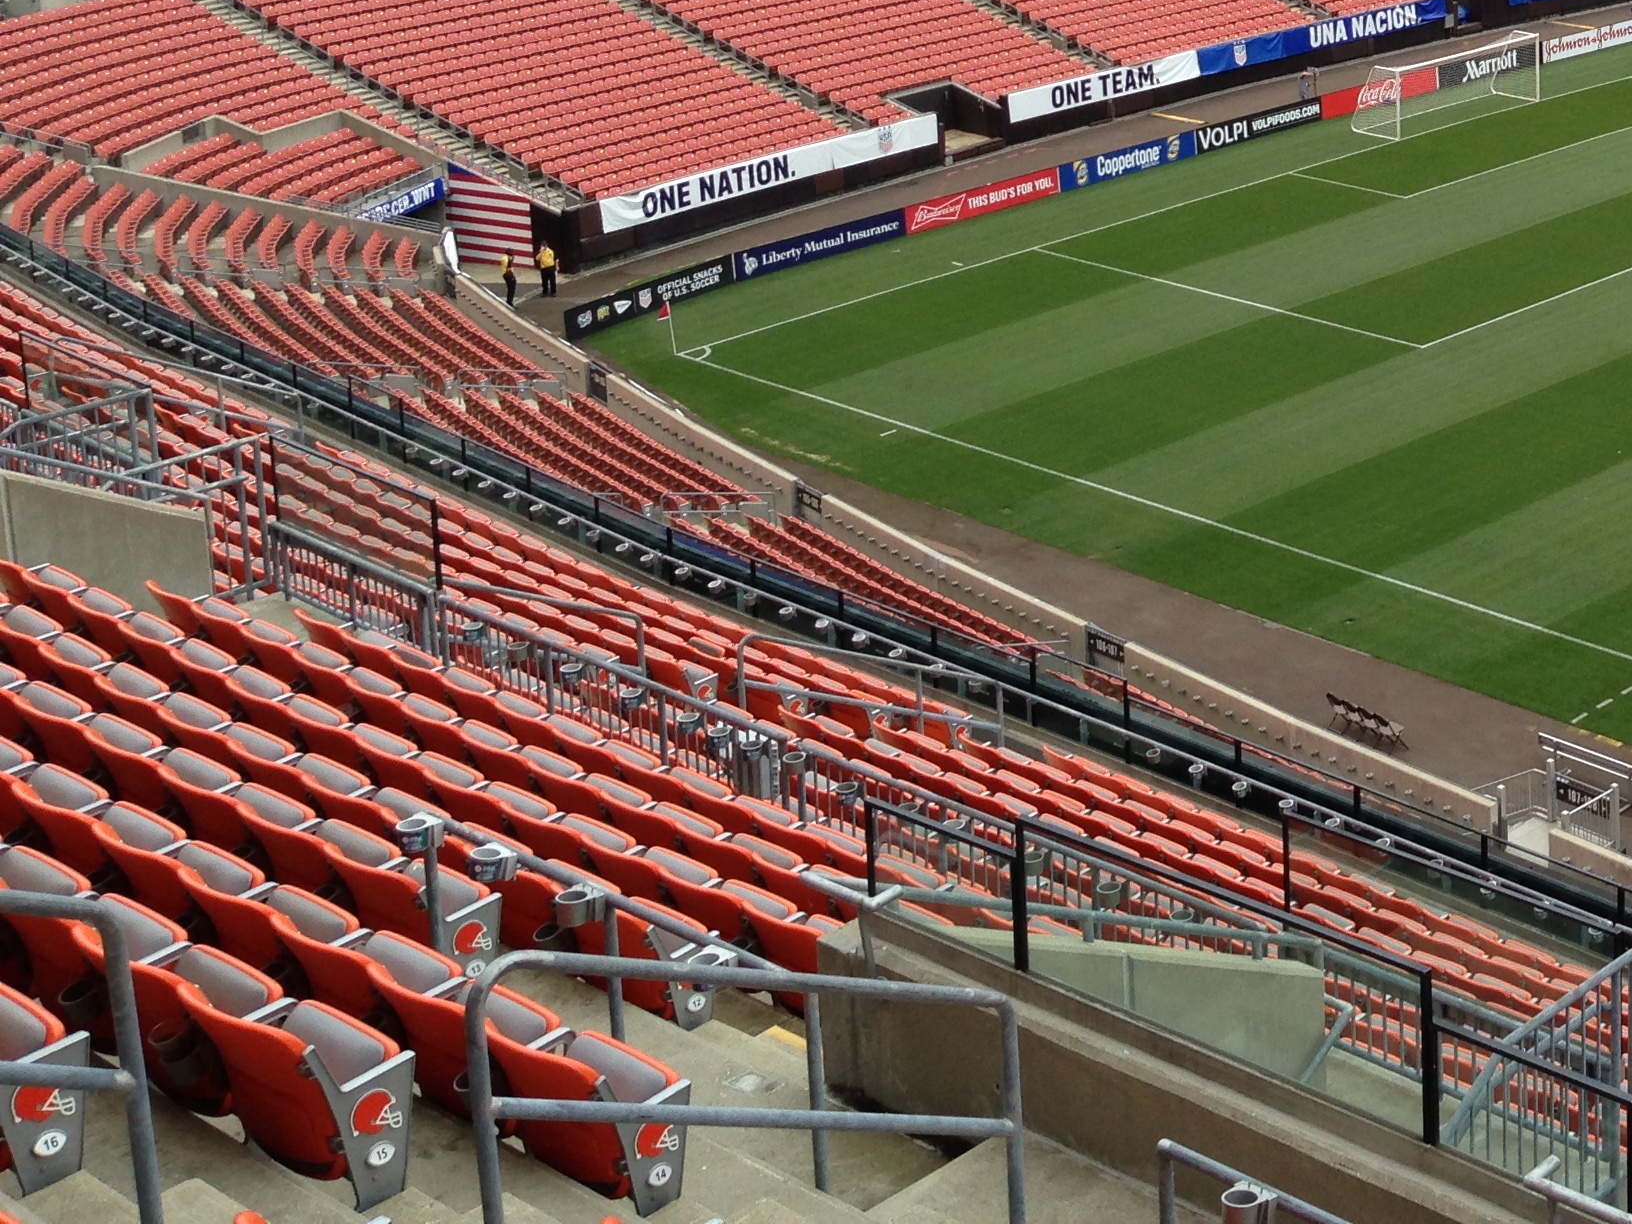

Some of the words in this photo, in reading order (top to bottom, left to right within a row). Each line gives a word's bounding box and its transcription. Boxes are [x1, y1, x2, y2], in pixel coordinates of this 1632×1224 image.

[1310, 20, 1348, 47] UNA
[1462, 49, 1518, 82] Marriott
[1051, 84, 1092, 108] ONE
[1098, 65, 1160, 98] TEAM.
[1198, 120, 1249, 149] VOLPI
[1252, 104, 1320, 131] VOLPIFOODS.COM
[1097, 146, 1161, 177] Coppertone
[641, 183, 692, 218] ONE
[700, 155, 796, 202] NATION.
[916, 196, 964, 222] Budweiser
[968, 192, 988, 210] THIS
[990, 186, 1014, 204] BUD'S
[1016, 182, 1033, 198] FOR
[1034, 177, 1054, 194] YOU.
[762, 246, 802, 266] Liberty
[804, 233, 844, 254] Mutual
[846, 220, 900, 243] Insurance
[657, 276, 692, 294] OFFICIAL
[693, 264, 722, 282] SNACKS
[662, 292, 673, 301] OF
[674, 286, 690, 298] U.S.
[691, 274, 720, 290] SOCCER
[692, 998, 703, 1008] 12
[43, 1136, 58, 1150] 16
[376, 1148, 388, 1161] 15
[655, 1168, 666, 1182] 14
[655, 1168, 666, 1182] 14
